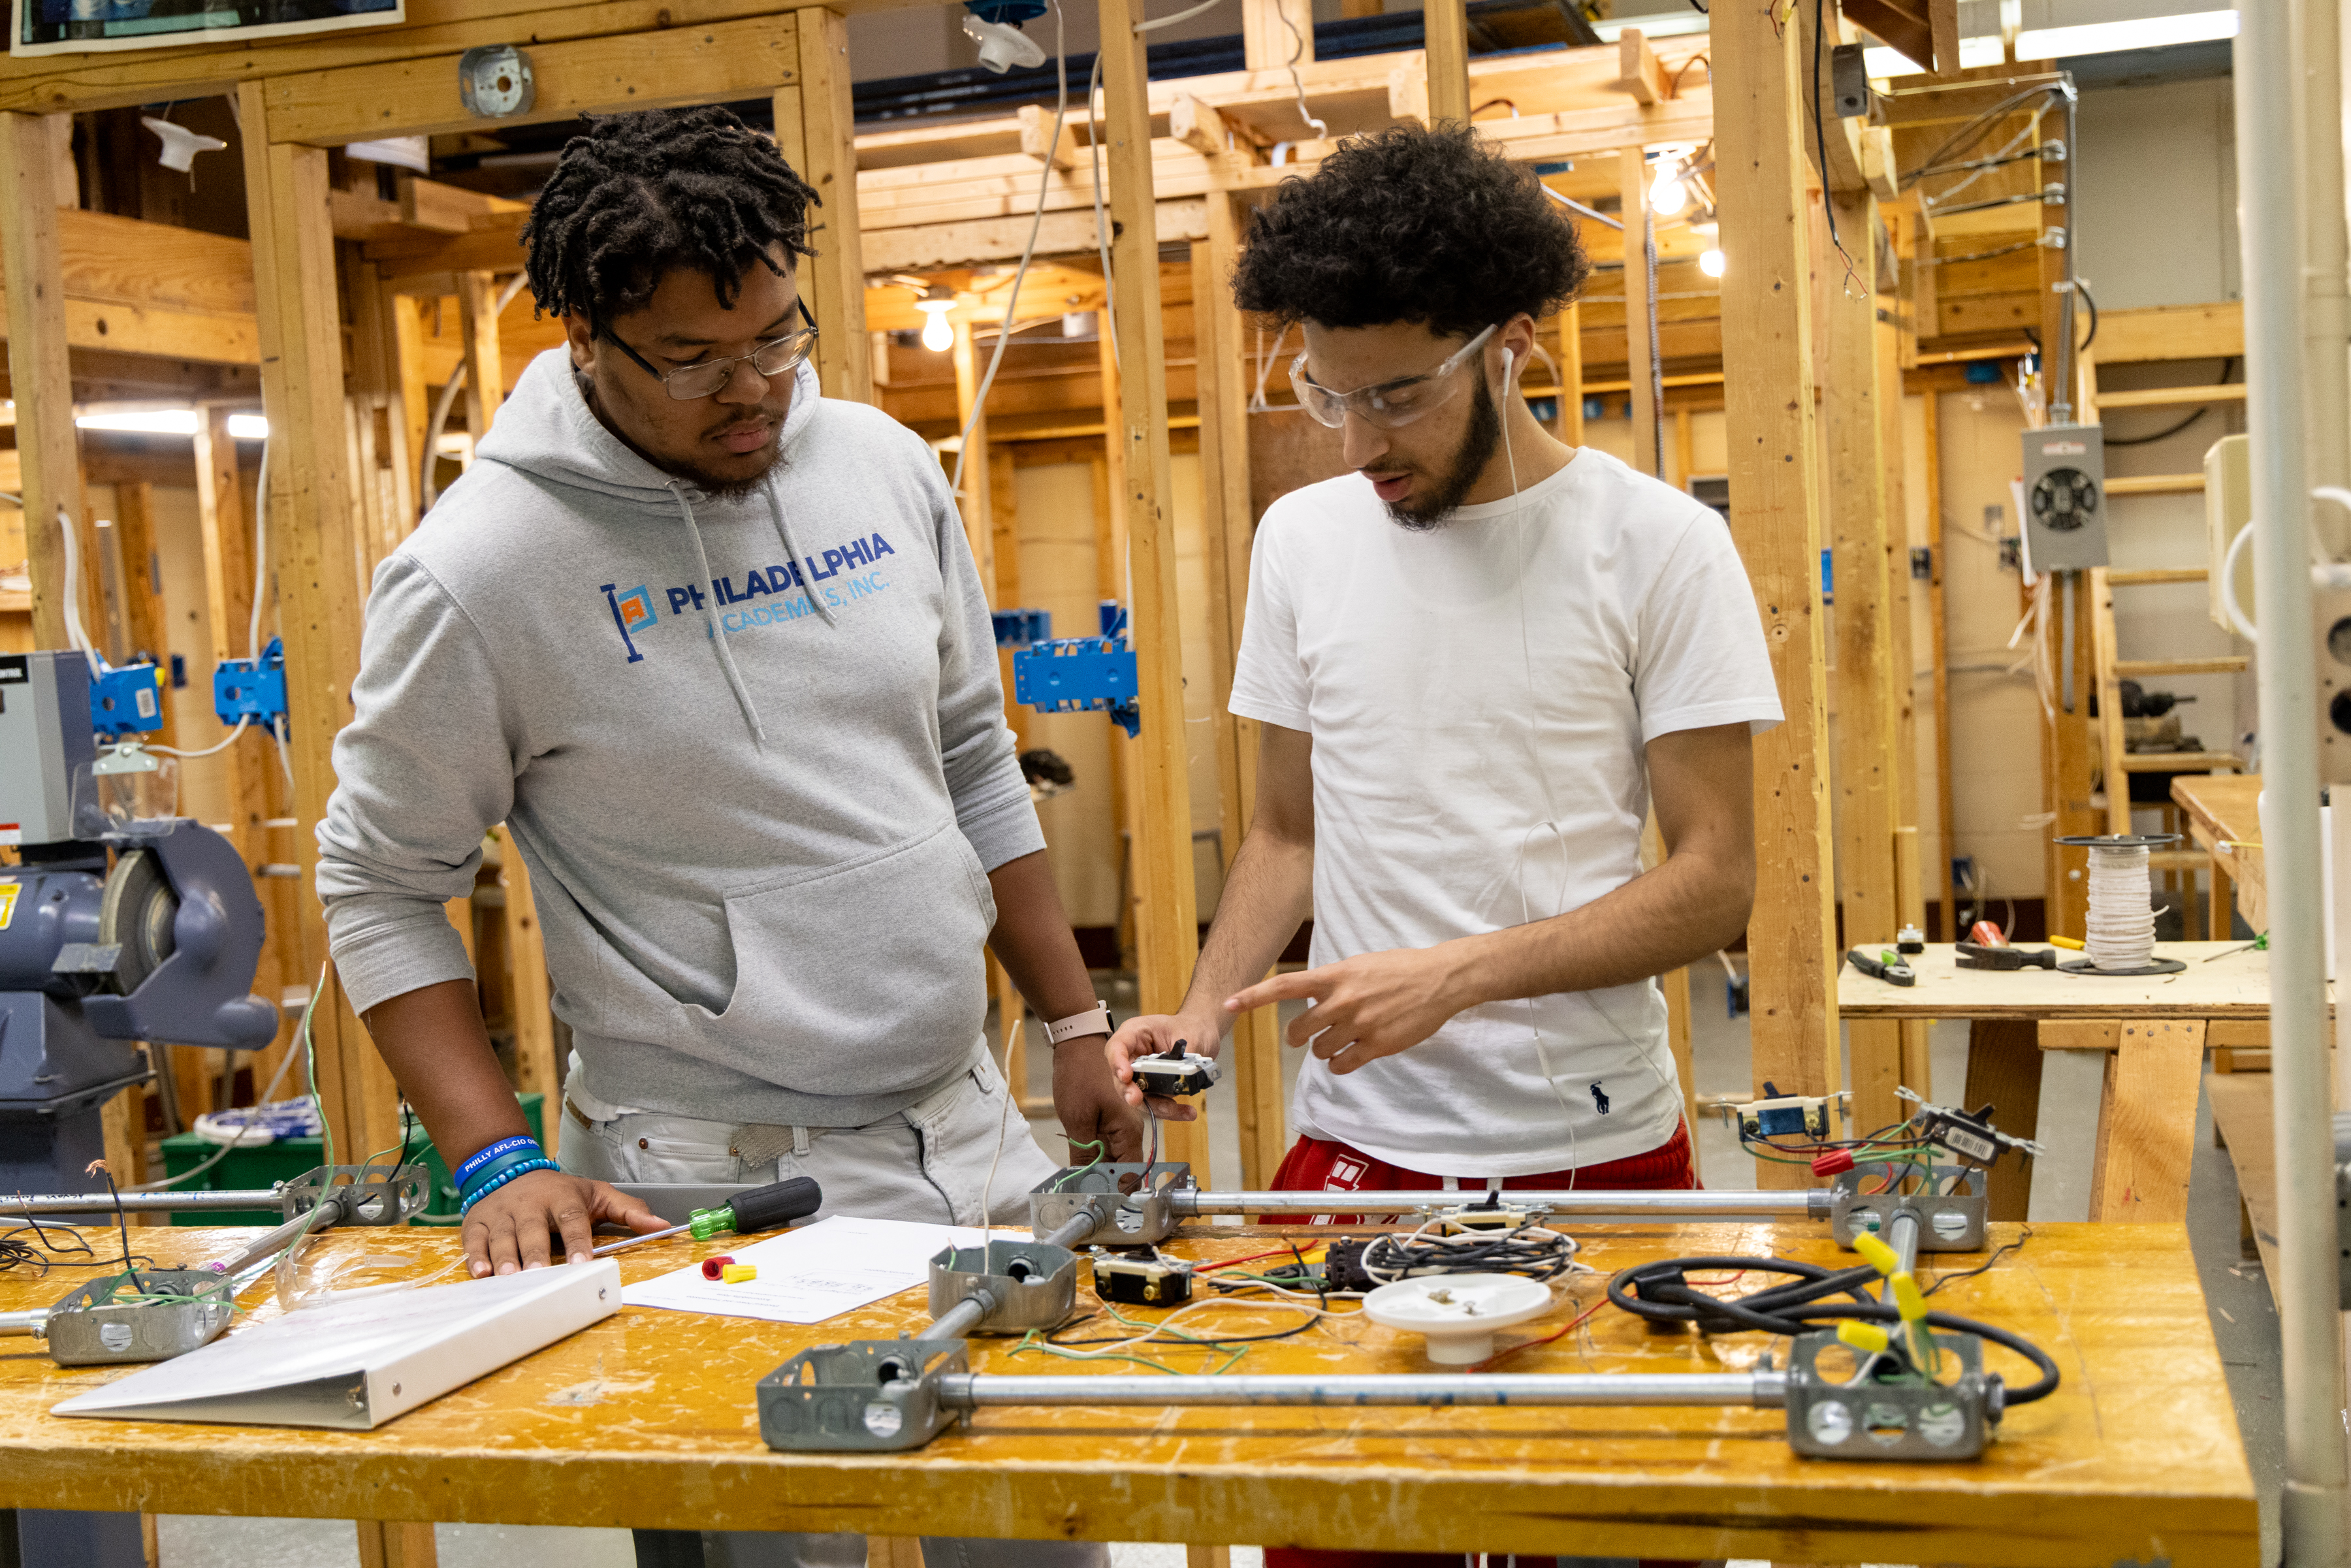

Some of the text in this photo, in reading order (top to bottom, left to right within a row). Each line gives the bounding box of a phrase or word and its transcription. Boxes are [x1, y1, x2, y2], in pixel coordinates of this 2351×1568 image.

[665, 532, 896, 615] PHILADELPHIA
[708, 571, 890, 639] CADEMIS, INC.
[464, 1150, 492, 1172] PHILLY
[494, 1138, 527, 1155] AFL-CIO
